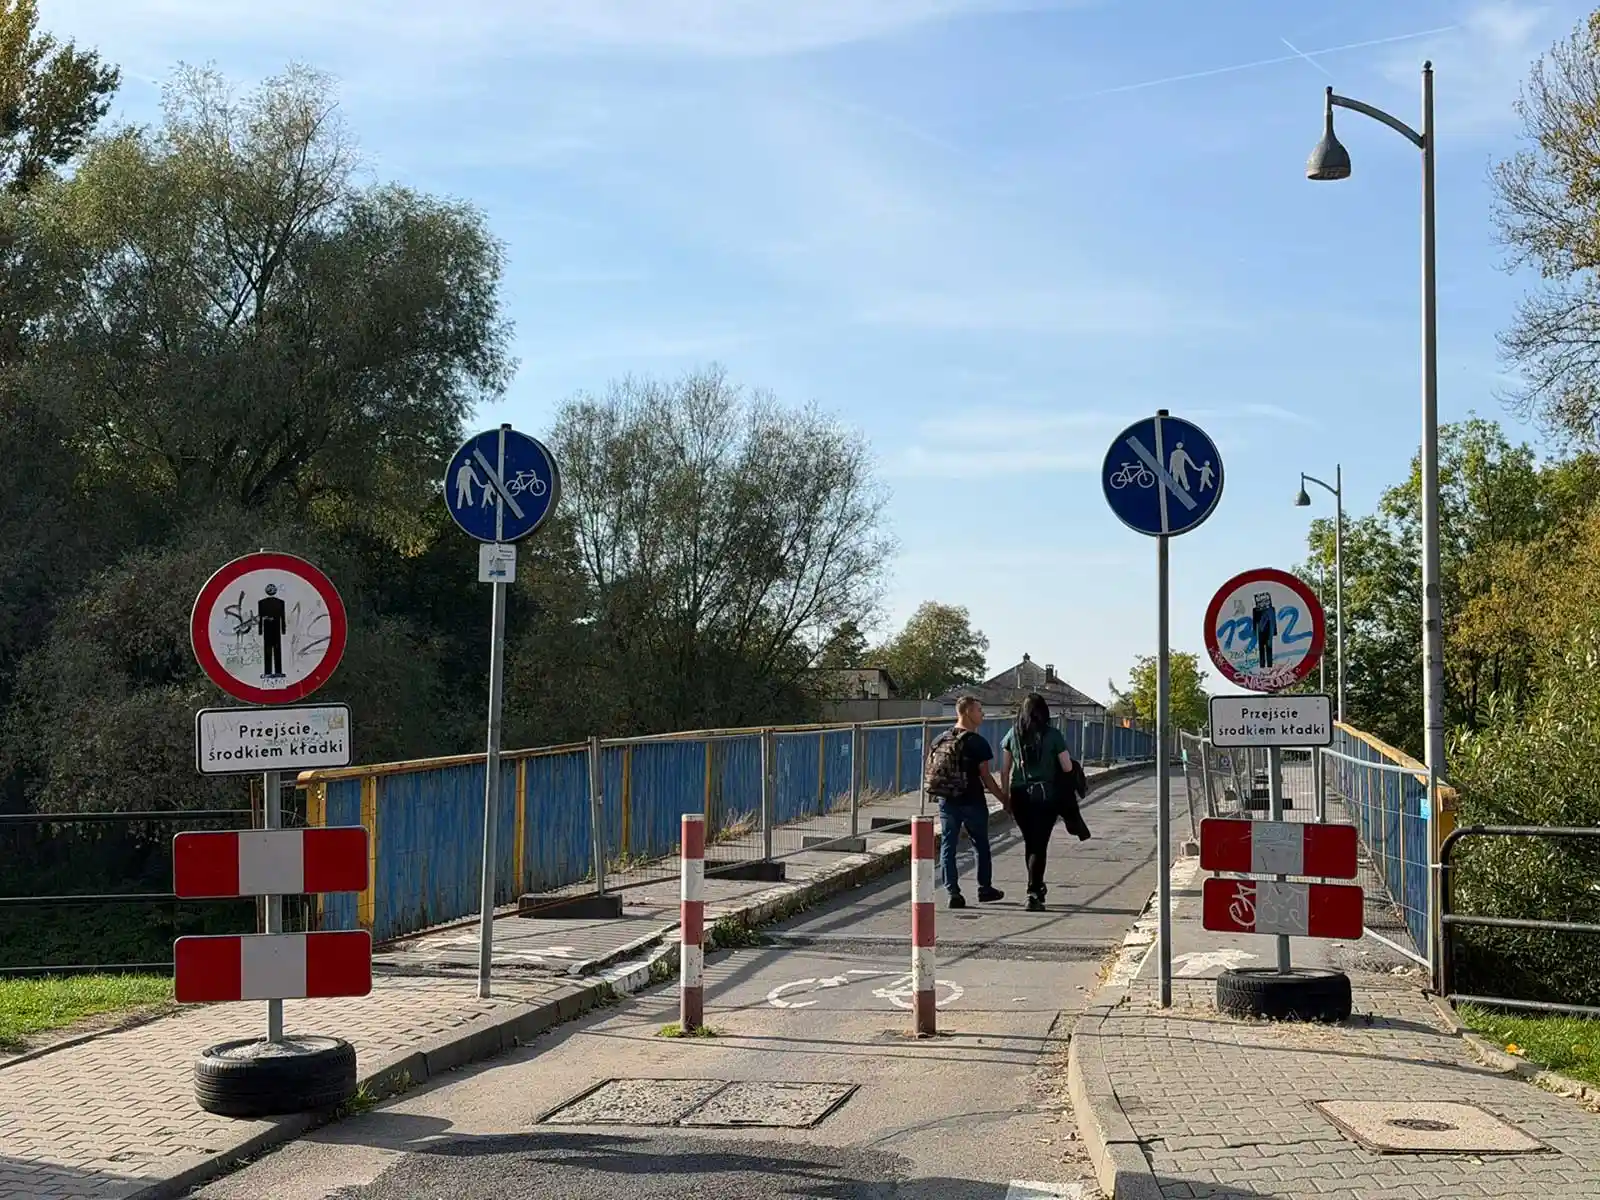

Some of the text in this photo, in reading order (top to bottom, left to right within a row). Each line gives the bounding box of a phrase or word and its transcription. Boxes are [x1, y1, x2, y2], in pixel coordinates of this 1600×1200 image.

[1241, 706, 1298, 722] Przejście
[239, 721, 311, 740] Przejście
[1218, 723, 1325, 736] środkiem kładki
[208, 744, 283, 761] środkiem
[290, 739, 343, 756] kładki
